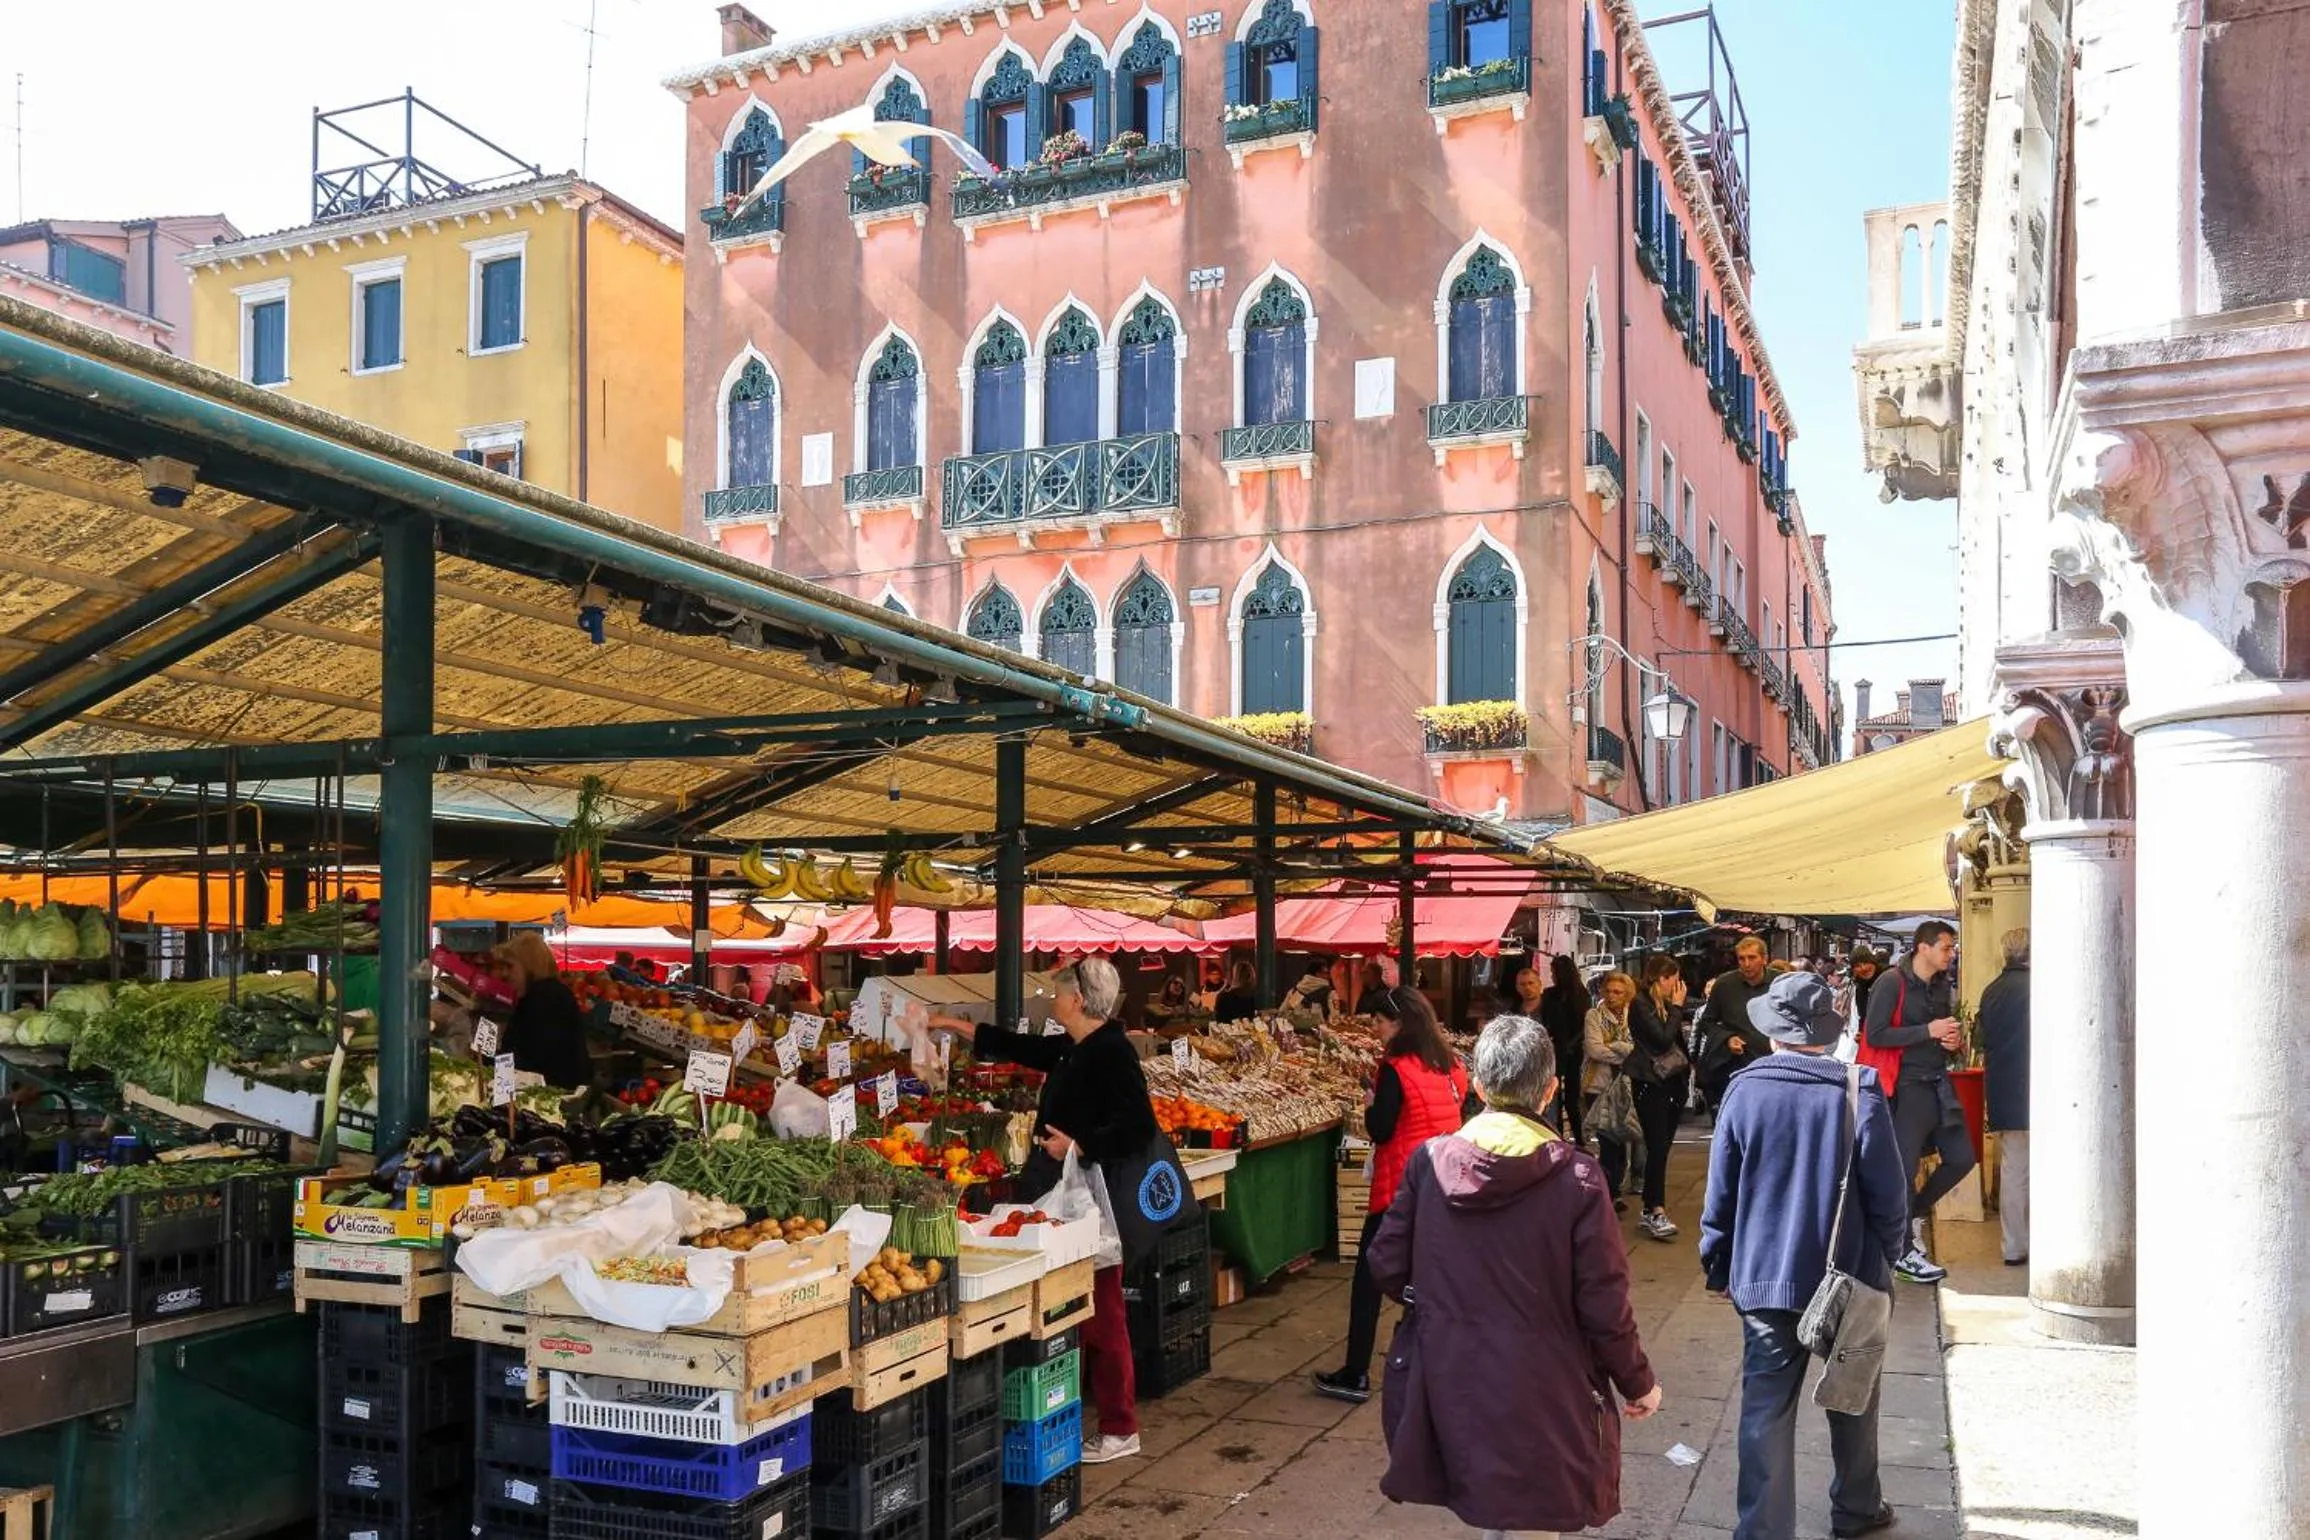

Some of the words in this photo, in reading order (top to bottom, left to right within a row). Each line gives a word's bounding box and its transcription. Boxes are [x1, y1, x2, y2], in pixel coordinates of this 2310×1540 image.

[336, 1214, 397, 1235] Melanzana
[459, 1208, 501, 1222] Melanza
[790, 1281, 820, 1305] FOSI
